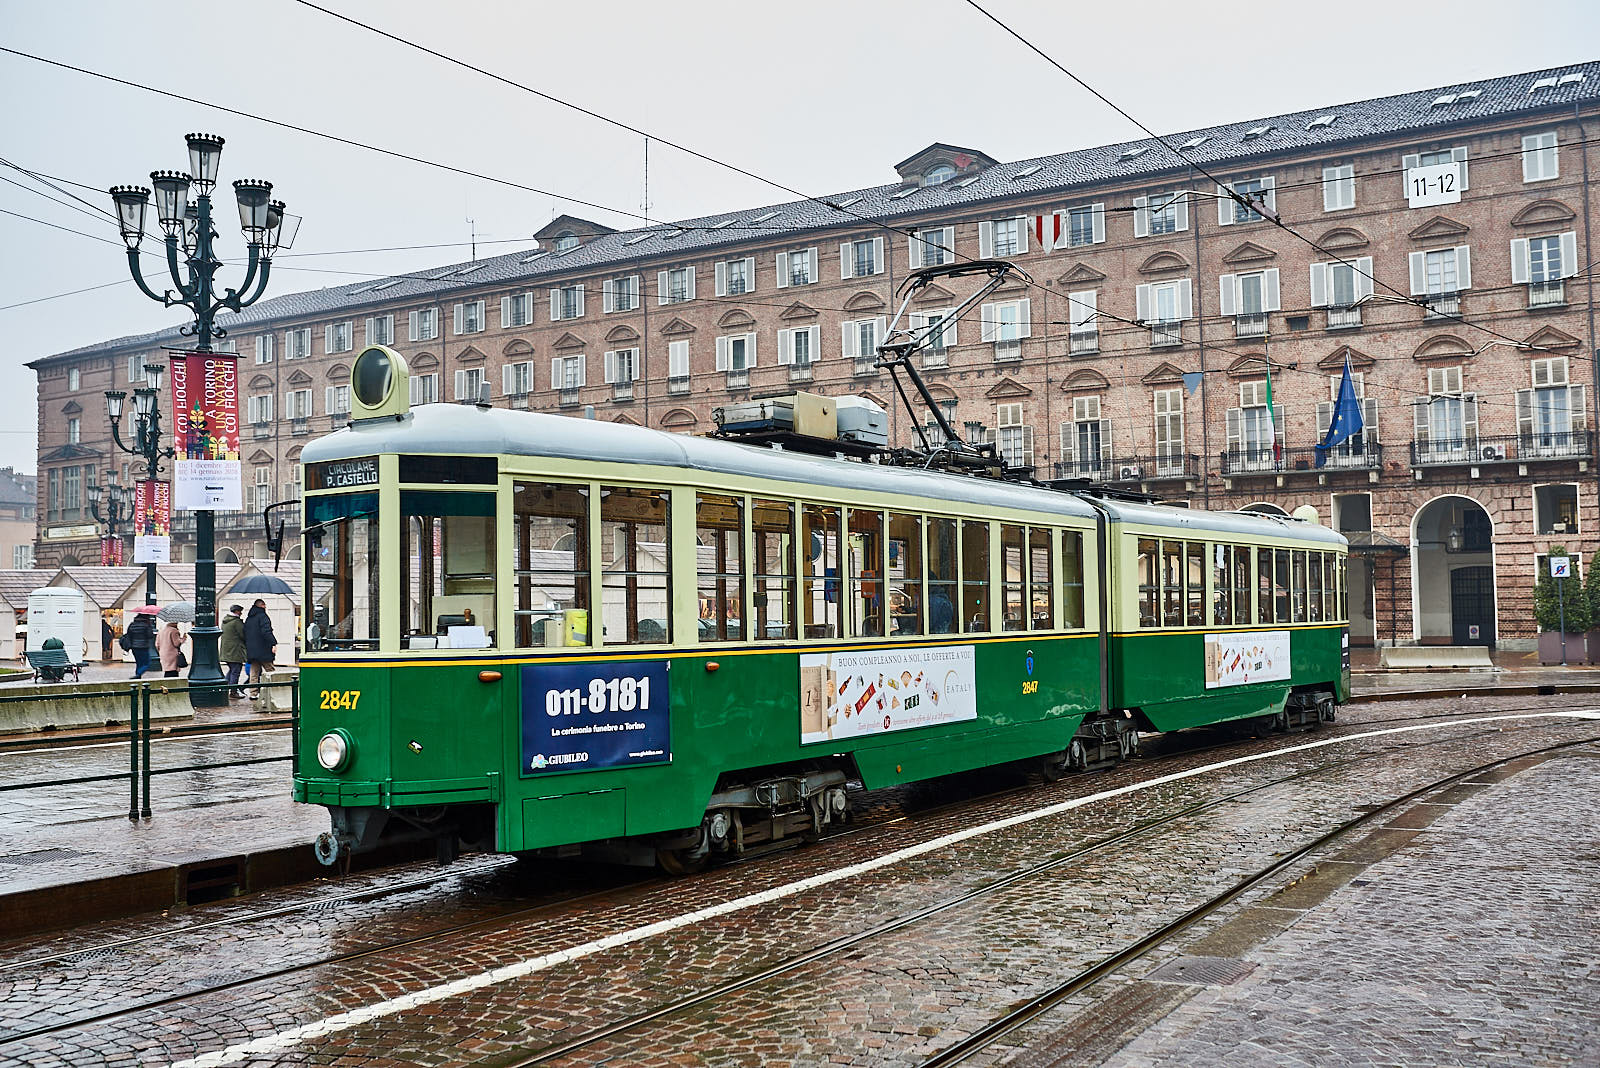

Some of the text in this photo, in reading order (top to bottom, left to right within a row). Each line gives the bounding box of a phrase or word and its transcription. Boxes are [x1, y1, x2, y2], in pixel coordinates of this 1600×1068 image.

[1413, 173, 1455, 197] 11-12
[204, 359, 216, 419] A TORINO
[214, 360, 226, 429] UN NATALE
[224, 361, 237, 434] COI FIOCCHI
[328, 460, 375, 476] CIRCOLARE
[326, 471, 378, 487] P. CASTELLO
[838, 656, 857, 667] BUON
[858, 653, 902, 666] COMPLEANNO
[922, 652, 930, 662] LE
[931, 651, 955, 661] OFFERTE
[545, 676, 650, 717] 011-8181
[1022, 680, 1039, 695] 2847
[320, 689, 361, 710] 2847
[551, 728, 560, 737] La
[561, 726, 592, 736] cerimonia
[593, 723, 618, 733] funebre
[624, 721, 646, 731] Torino
[548, 752, 589, 765] GIUBILEO
